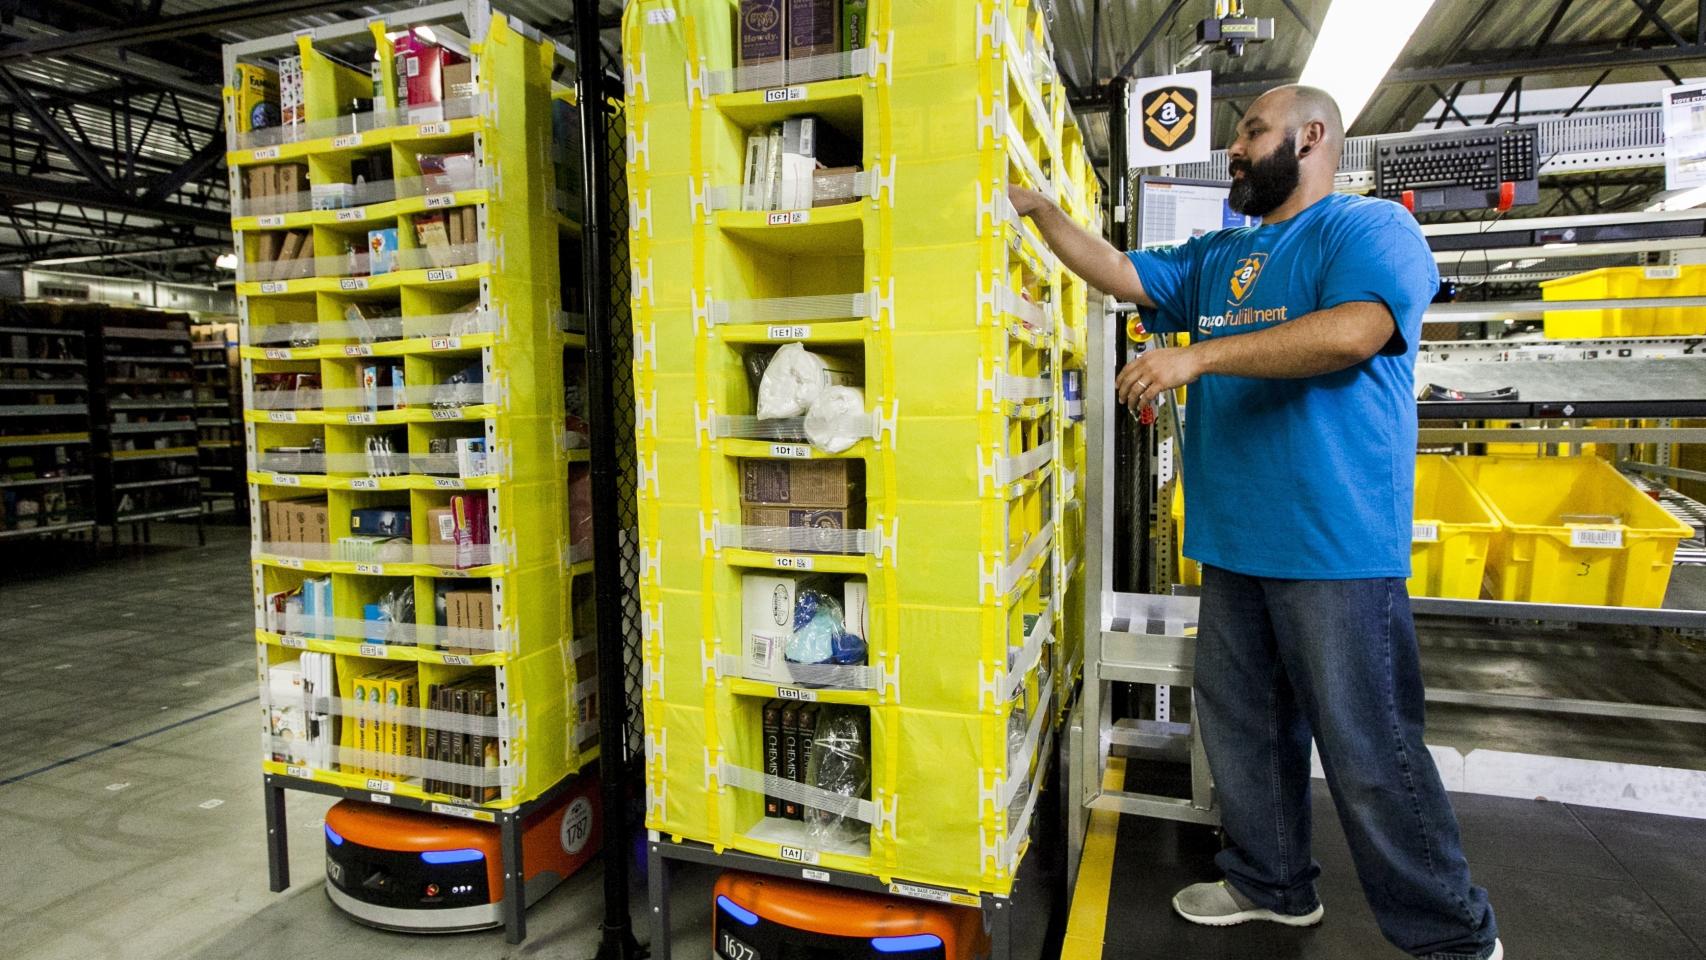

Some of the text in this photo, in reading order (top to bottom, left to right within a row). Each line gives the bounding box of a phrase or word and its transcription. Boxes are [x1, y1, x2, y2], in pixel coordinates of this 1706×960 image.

[769, 735, 778, 778] CHEMIST
[787, 736, 796, 781] CHEMIST
[566, 815, 588, 847] 1787
[724, 934, 754, 960] 1627
